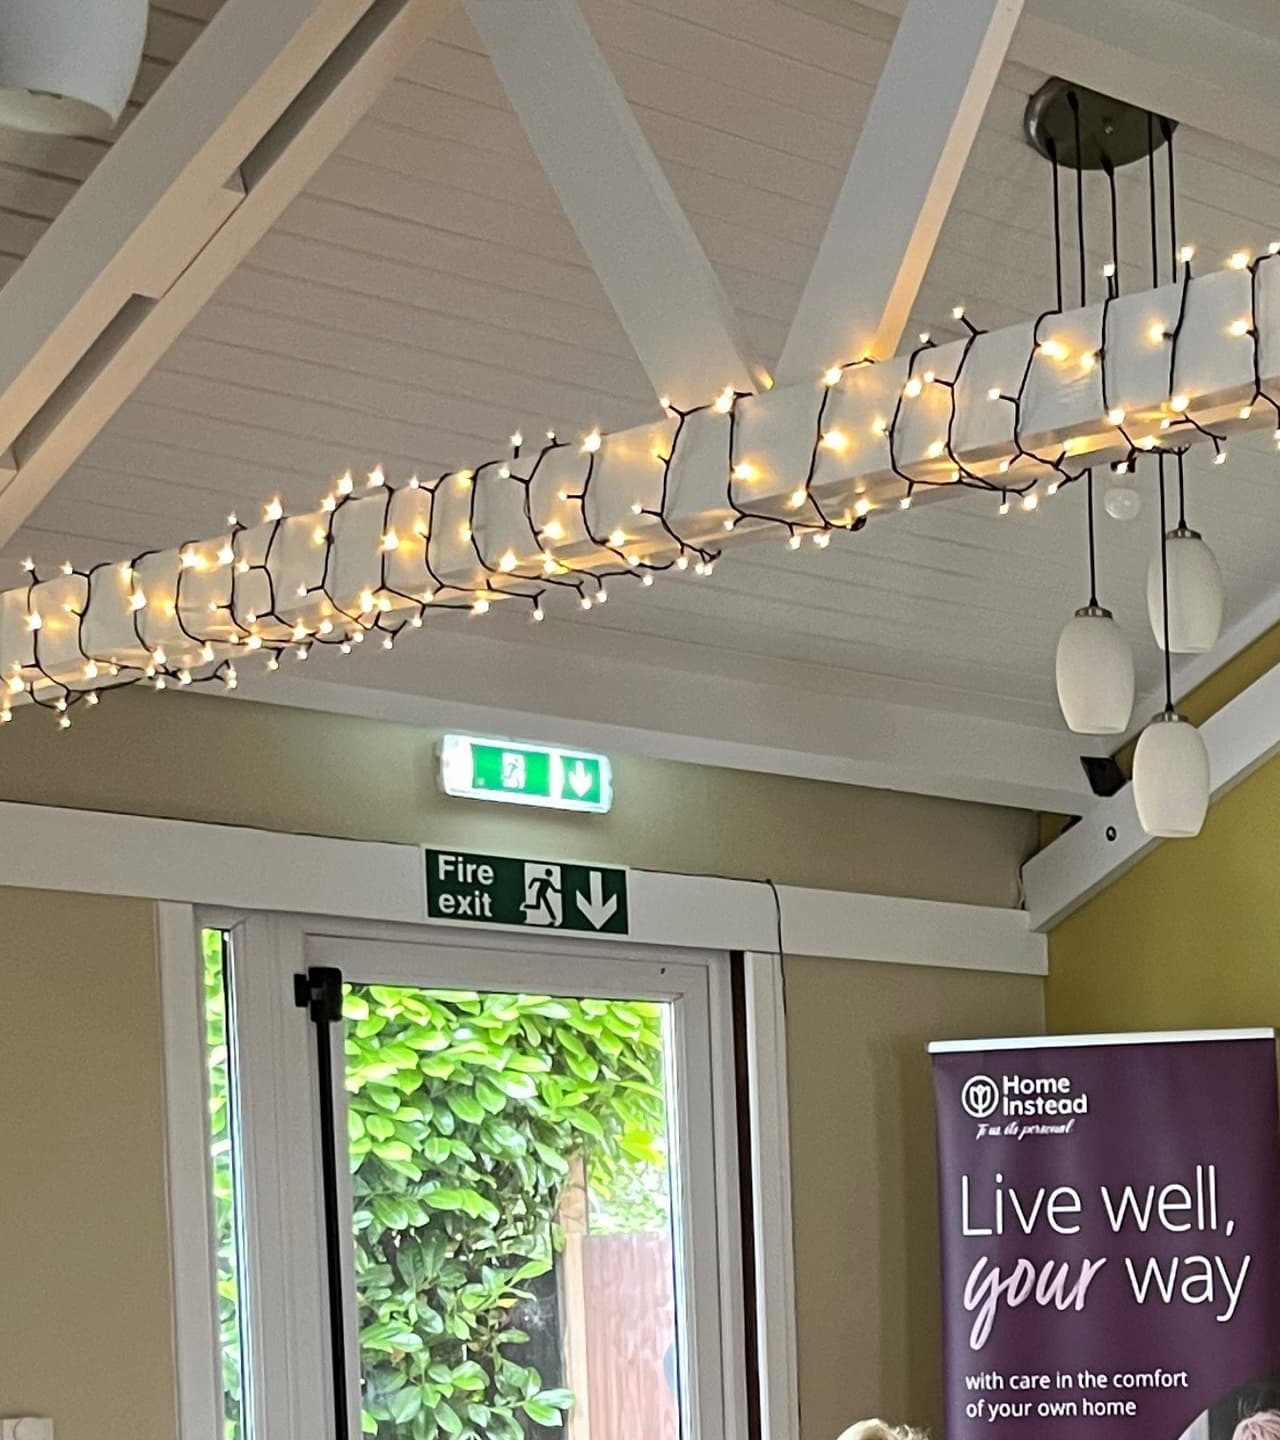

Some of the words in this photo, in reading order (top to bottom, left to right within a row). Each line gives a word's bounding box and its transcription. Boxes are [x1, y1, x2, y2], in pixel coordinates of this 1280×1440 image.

[437, 854, 495, 886] Fire
[438, 890, 493, 918] exit
[1002, 1074, 1071, 1096] Home
[1002, 1093, 1088, 1116] Instead
[961, 1172, 1082, 1237] Live
[1100, 1164, 1235, 1237] well,
[963, 1255, 1108, 1351] your
[1125, 1254, 1251, 1322] way
[965, 1371, 1004, 1390] with
[1009, 1374, 1051, 1390] care
[1056, 1370, 1073, 1389] in
[1078, 1369, 1108, 1388] the
[1112, 1368, 1189, 1388] comfort
[965, 1399, 985, 1418] of
[986, 1402, 1032, 1422] your
[1037, 1401, 1077, 1417] own
[1082, 1397, 1137, 1416] home
